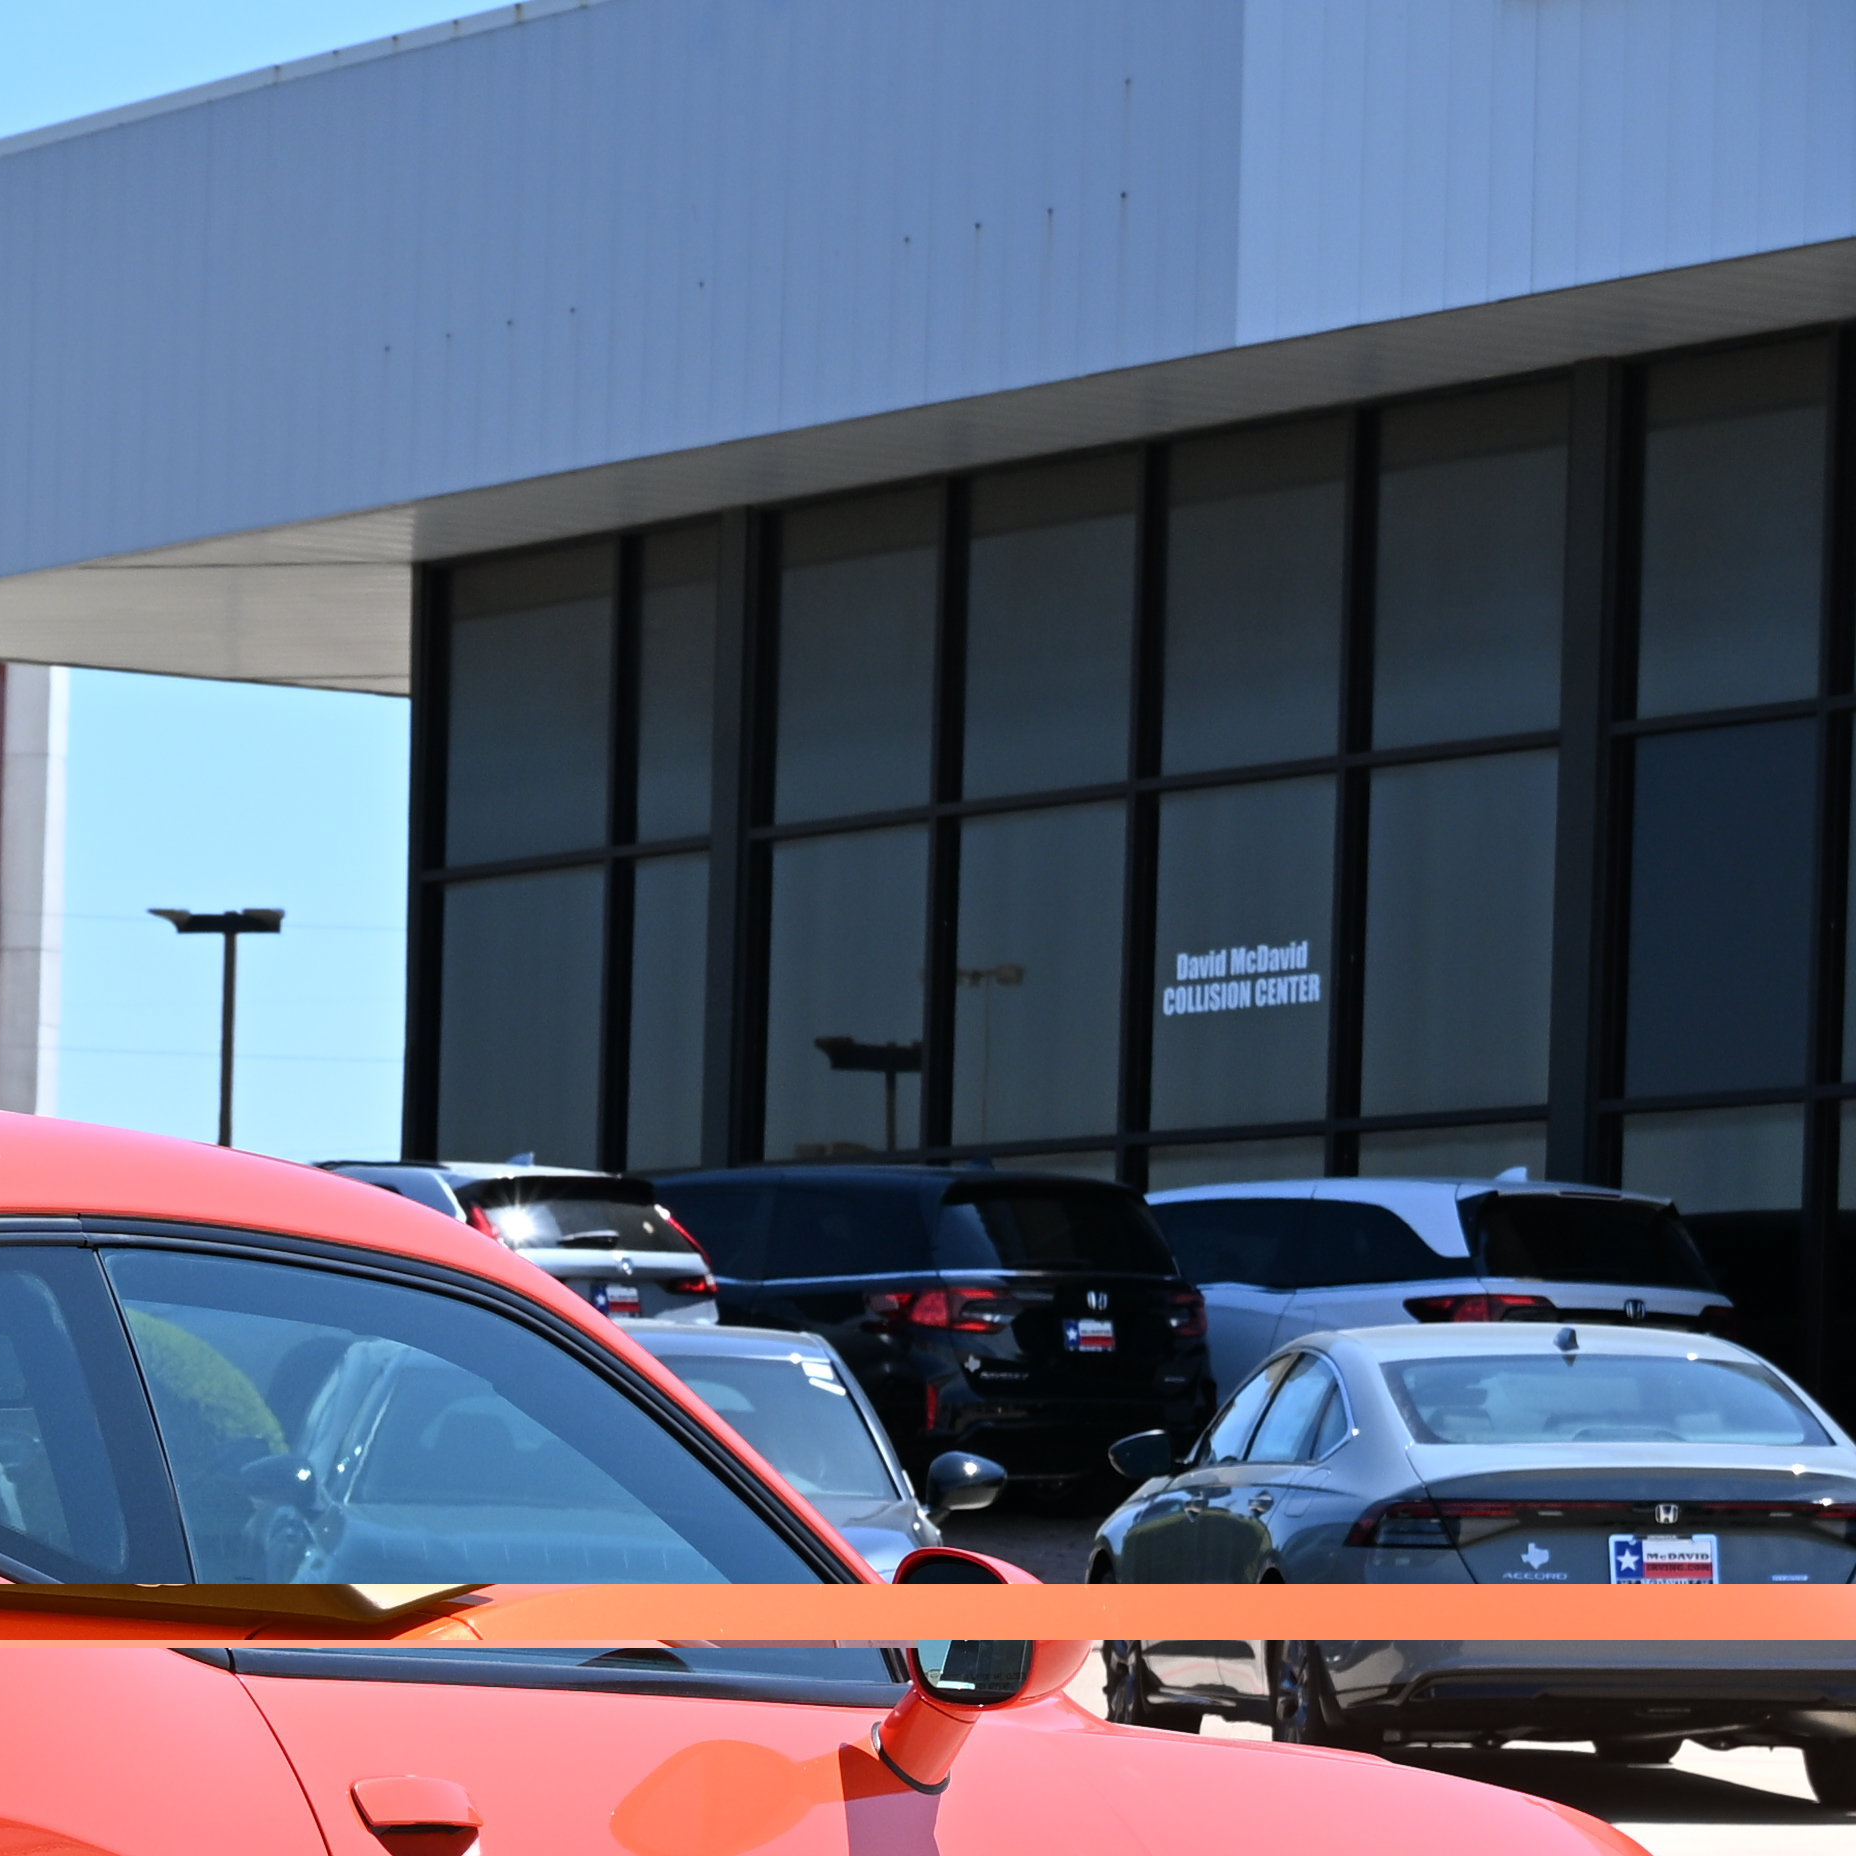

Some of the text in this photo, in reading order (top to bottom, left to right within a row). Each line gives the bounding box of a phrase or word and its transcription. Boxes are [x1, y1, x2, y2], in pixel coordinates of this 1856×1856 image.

[1176, 940, 1308, 981] David McDavid
[1163, 973, 1321, 1016] COLLISION CENTER
[1646, 1552, 1710, 1561] McDAVID
[1502, 1571, 1568, 1580] ACCORD
